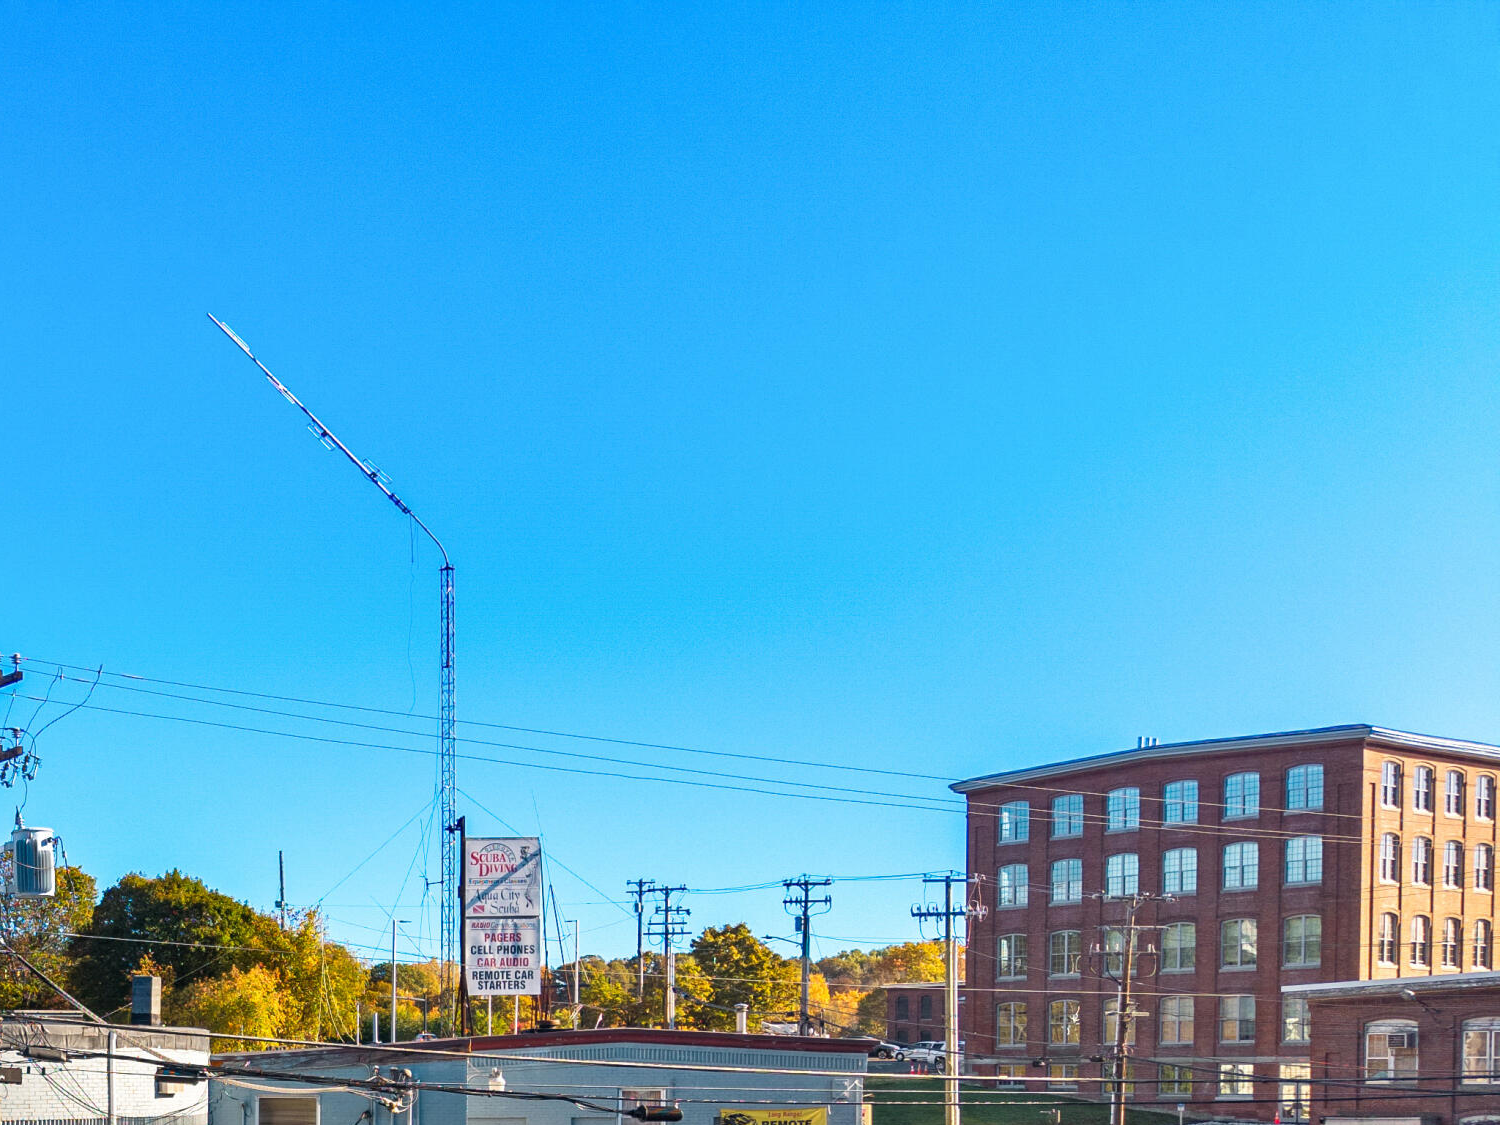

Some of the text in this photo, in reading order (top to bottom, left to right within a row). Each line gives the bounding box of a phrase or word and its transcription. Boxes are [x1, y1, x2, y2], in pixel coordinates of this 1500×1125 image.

[470, 851, 506, 866] SCUBA
[479, 863, 518, 877] DIVING
[476, 888, 520, 906] Aqua City
[490, 902, 520, 914] Scuba
[484, 933, 522, 942] PAGERS
[470, 945, 535, 955] CELL PHONES
[477, 958, 529, 967] CAR AUDIO
[472, 970, 534, 980] REMOTE CAR
[478, 980, 526, 990] STARTERS
